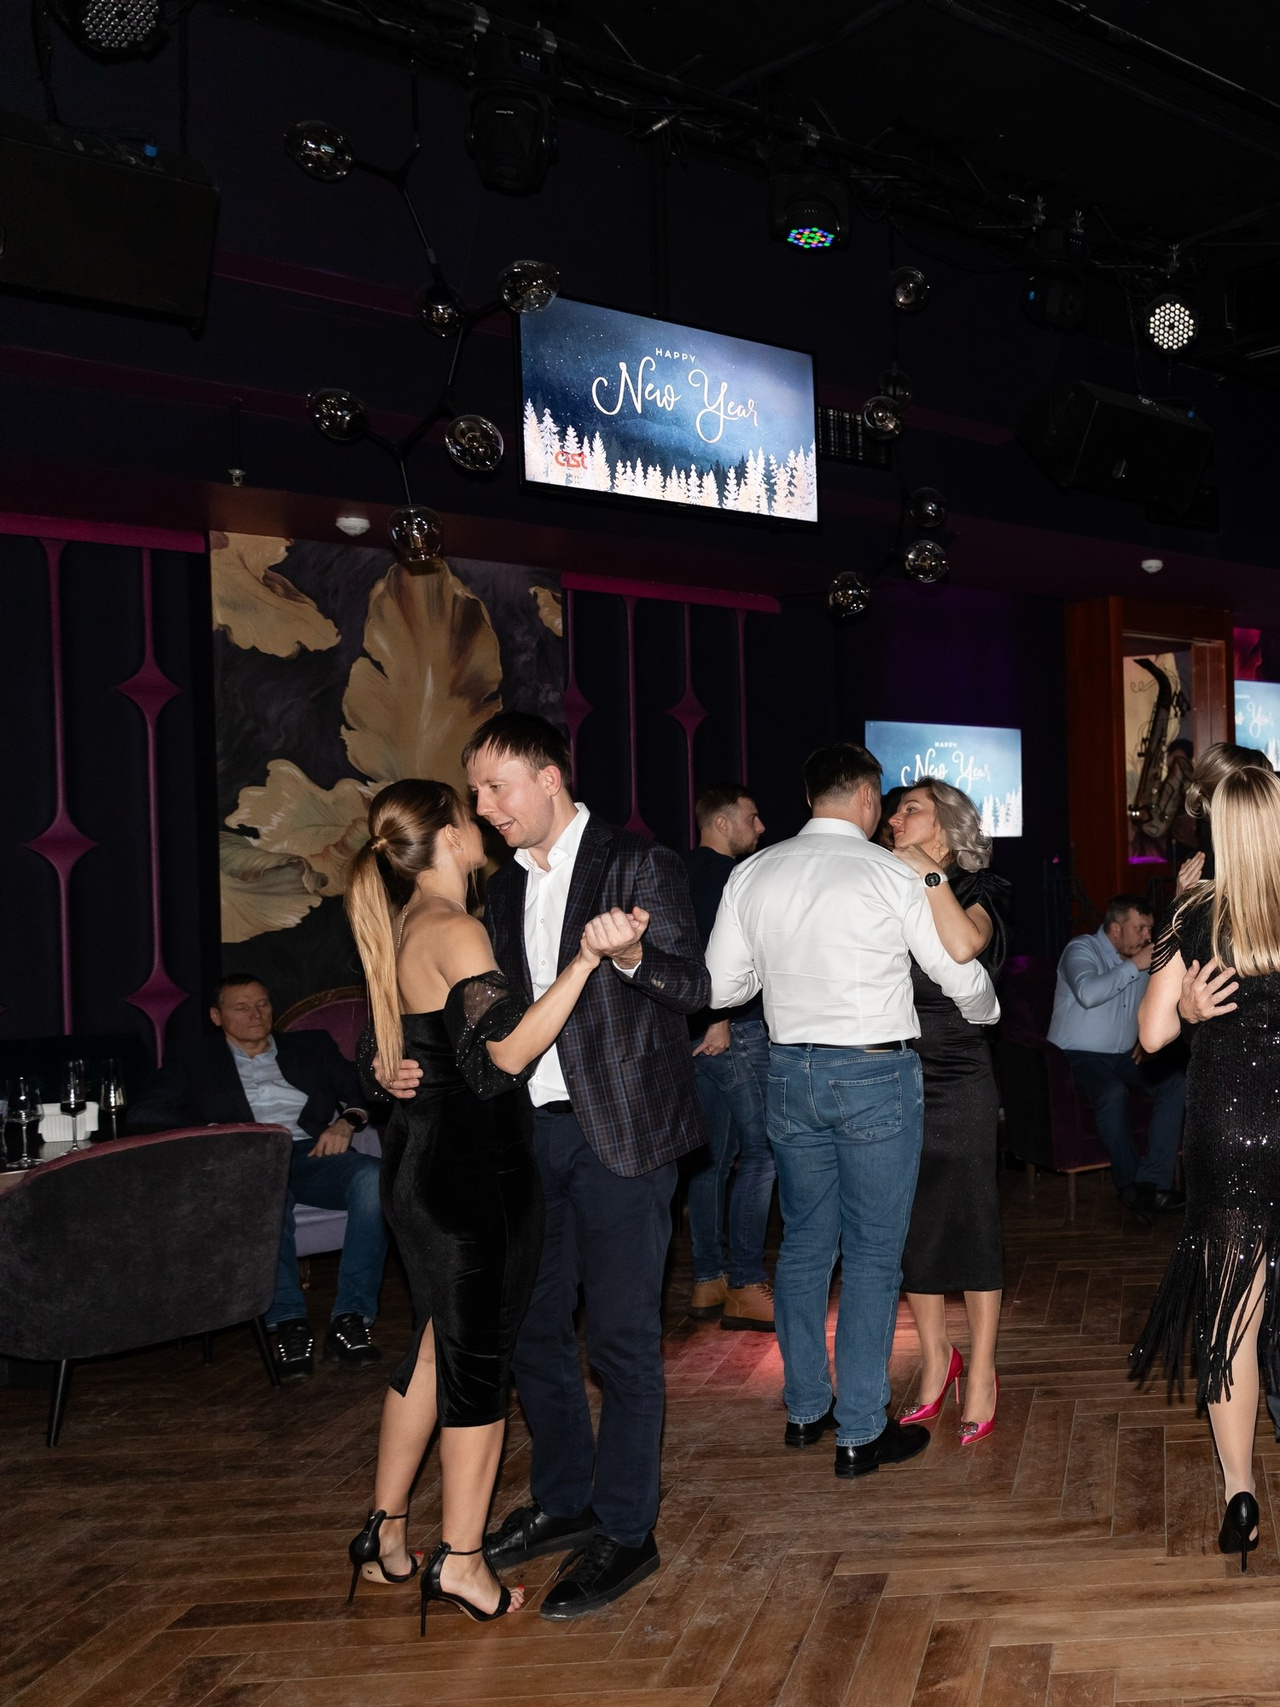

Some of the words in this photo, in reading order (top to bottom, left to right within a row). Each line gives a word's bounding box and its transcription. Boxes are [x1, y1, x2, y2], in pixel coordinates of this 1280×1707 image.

[655, 347, 697, 363] HAPPY
[591, 356, 682, 416] New
[688, 368, 759, 444] Year
[900, 747, 949, 787] New
[951, 750, 991, 794] Year
